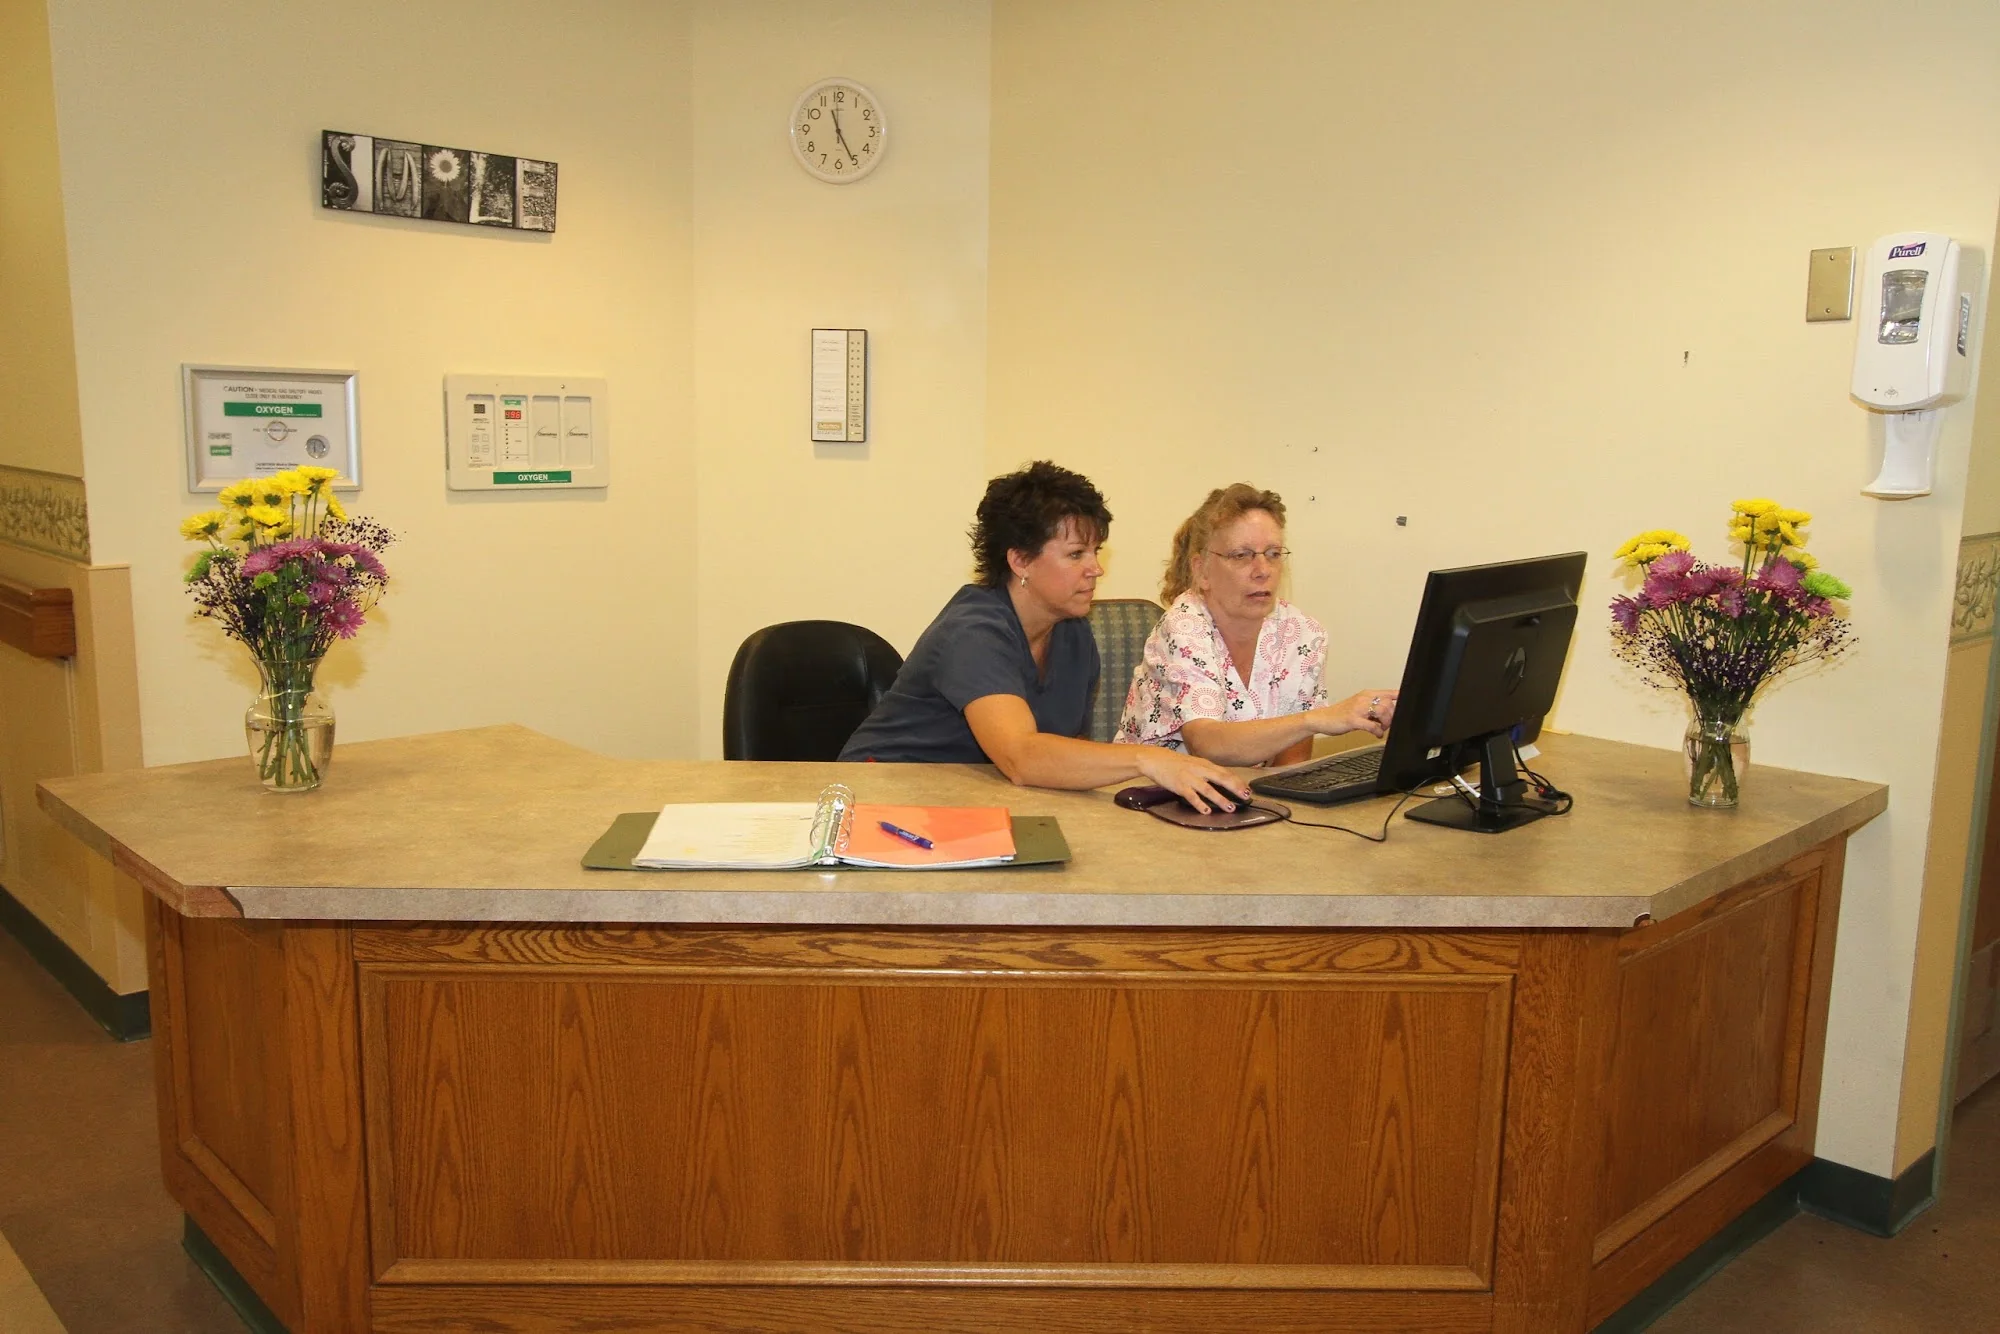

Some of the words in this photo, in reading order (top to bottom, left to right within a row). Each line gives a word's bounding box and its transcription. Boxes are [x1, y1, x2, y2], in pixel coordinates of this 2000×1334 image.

[820, 95, 827, 107] 11
[833, 91, 845, 103] 12
[807, 108, 821, 120] 10
[862, 109, 871, 121] 2
[802, 124, 811, 136] 9
[868, 126, 876, 138] 3
[807, 141, 815, 153] 8
[862, 143, 870, 154] 4
[820, 153, 828, 165] 7
[834, 158, 843, 170] 6
[851, 154, 859, 166] 5
[1892, 246, 1922, 257] Purell
[1958, 303, 1969, 348] Purell
[223, 385, 254, 393] CAUTION
[255, 405, 293, 414] OXYGEN
[517, 473, 549, 481] OXYGEN
